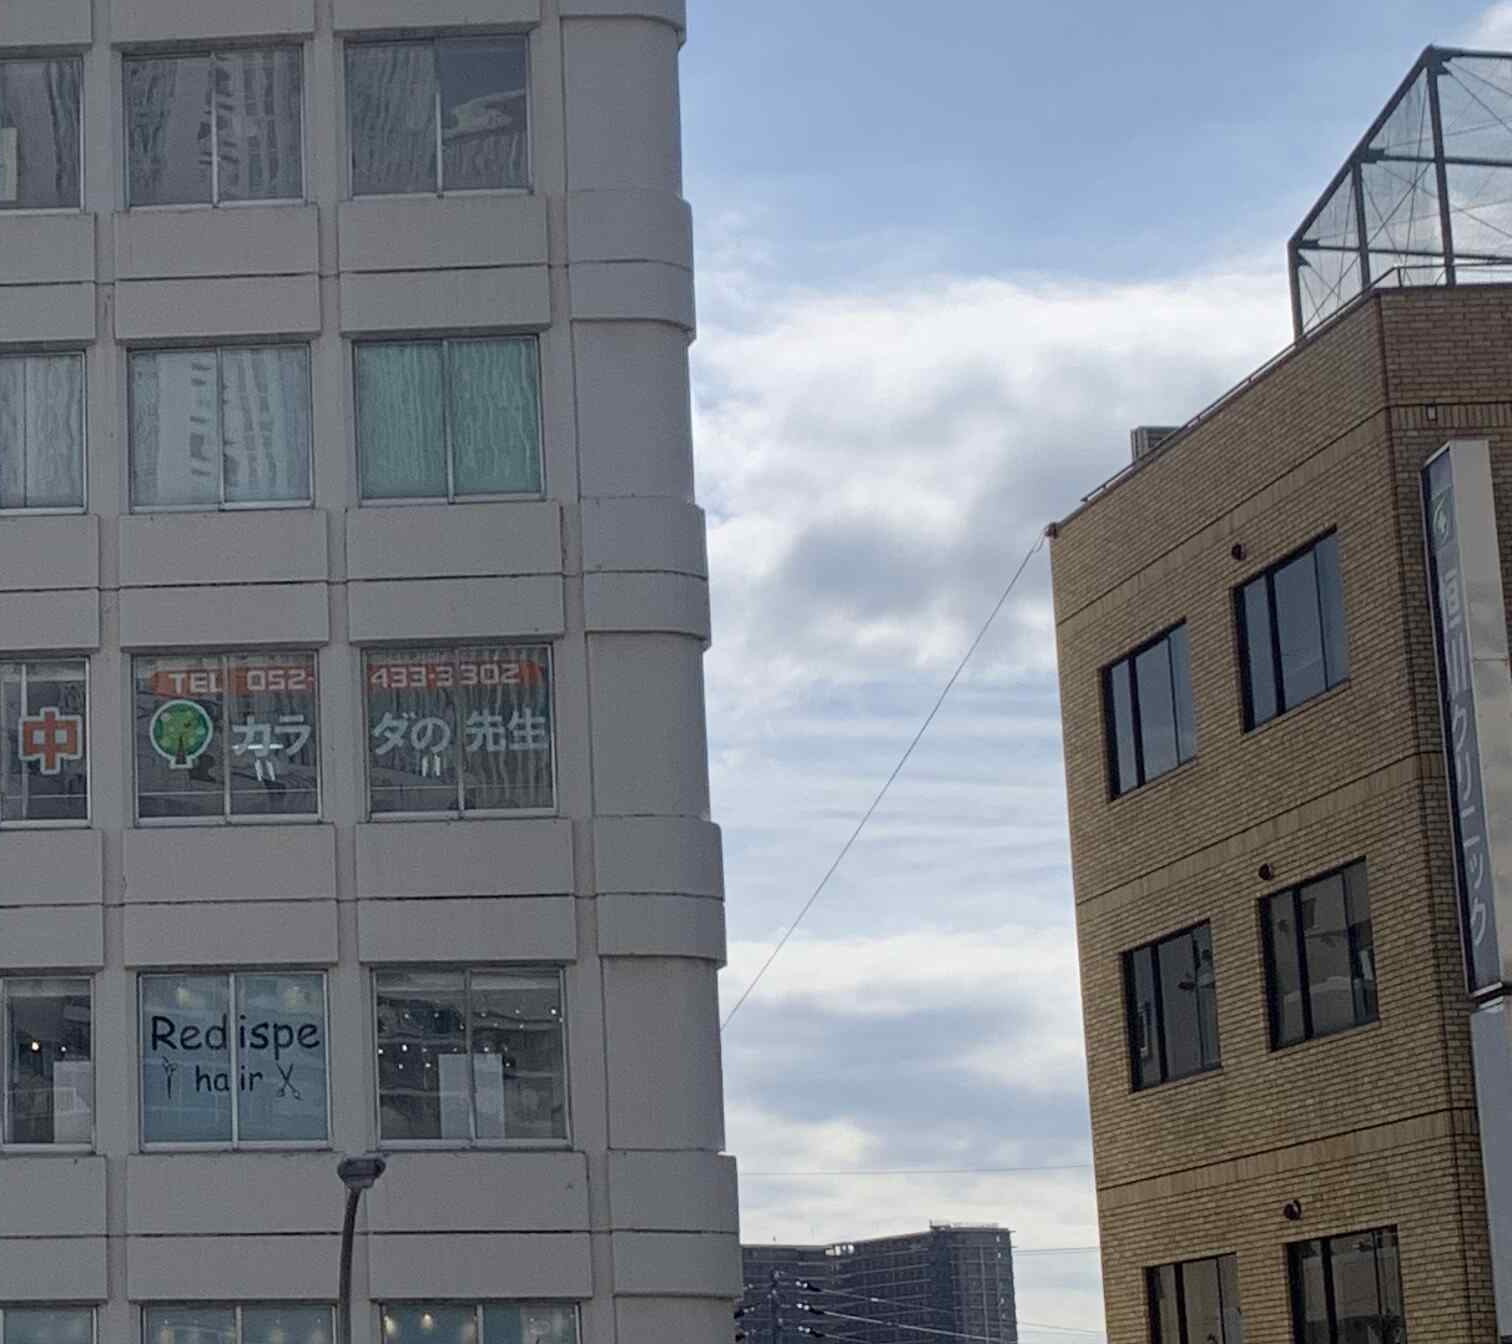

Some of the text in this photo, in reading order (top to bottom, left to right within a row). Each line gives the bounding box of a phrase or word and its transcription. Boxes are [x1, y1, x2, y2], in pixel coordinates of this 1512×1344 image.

[170, 664, 521, 694] TEL 052-433-3302
[232, 710, 548, 756] カラダの先生
[151, 1015, 321, 1060] Redispe
[195, 1065, 263, 1093] hair
